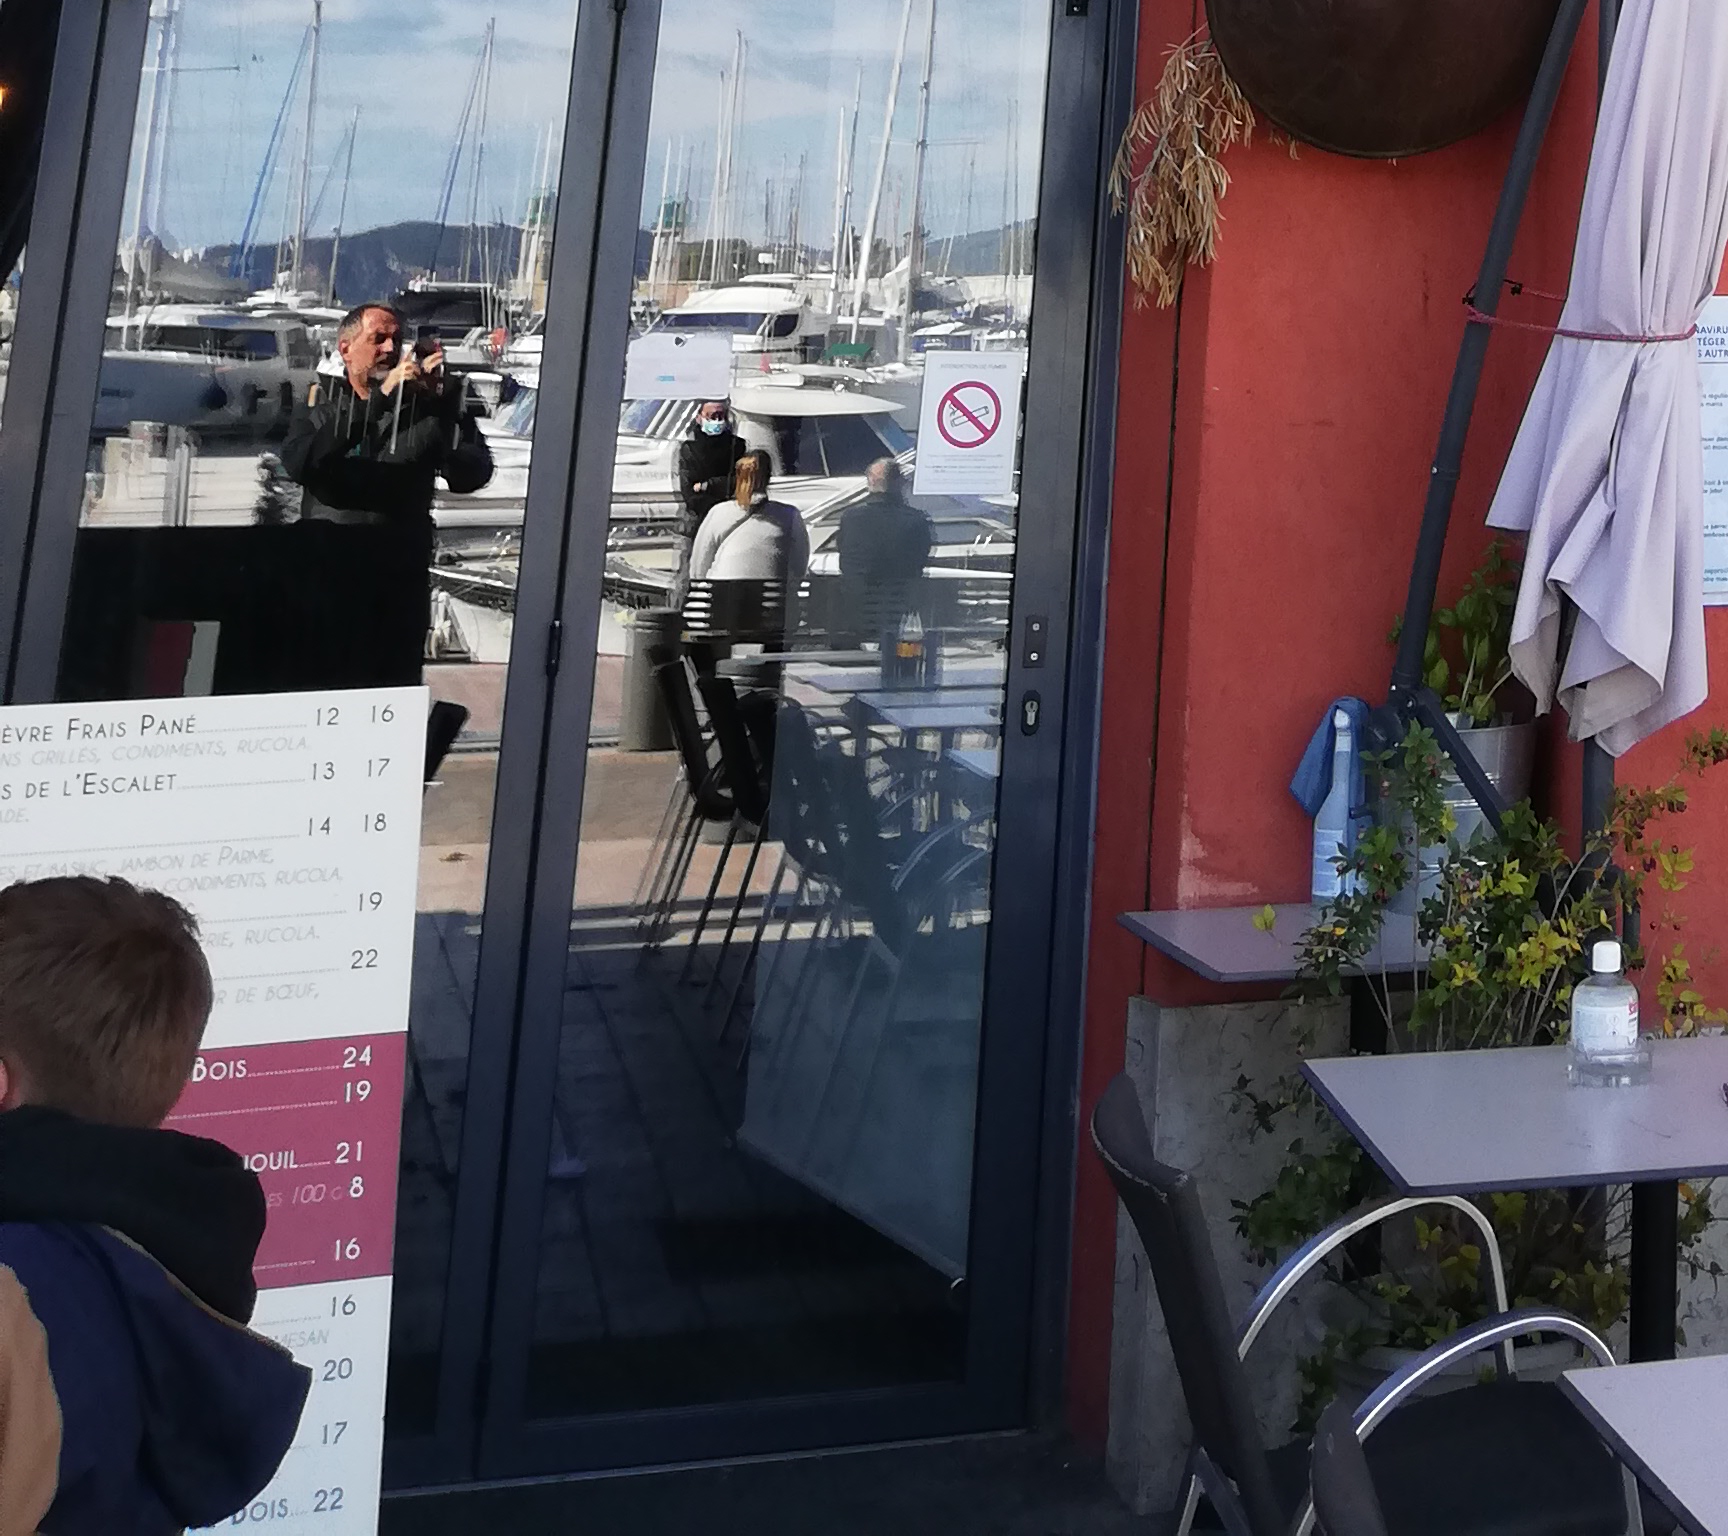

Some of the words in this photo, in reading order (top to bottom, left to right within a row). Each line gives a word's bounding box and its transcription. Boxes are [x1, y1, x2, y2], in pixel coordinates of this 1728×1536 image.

[66, 716, 127, 741] FRAIS
[140, 713, 197, 736] PANÉ
[315, 706, 340, 728] 12
[371, 703, 395, 725] 16
[112, 738, 227, 763] CONDIMENTS,
[25, 778, 50, 799] DE
[62, 771, 177, 798] L'ESCALET
[312, 761, 335, 783] 13
[366, 758, 391, 779] 17
[307, 816, 331, 837] 14
[363, 812, 387, 834] 18
[117, 853, 185, 875] JAMBON
[190, 850, 211, 868] DE
[358, 892, 383, 913] 19
[351, 949, 379, 970] 22
[235, 985, 258, 1004] DE
[192, 1057, 247, 1083] BOIS
[343, 1046, 372, 1069] 24
[343, 1080, 372, 1104] 19
[335, 1141, 363, 1165] 21
[349, 1175, 365, 1199] 8
[334, 1238, 361, 1261] 16
[331, 1294, 356, 1317] 16
[323, 1357, 354, 1383] 20
[321, 1421, 348, 1446] 17
[314, 1487, 344, 1514] 22
